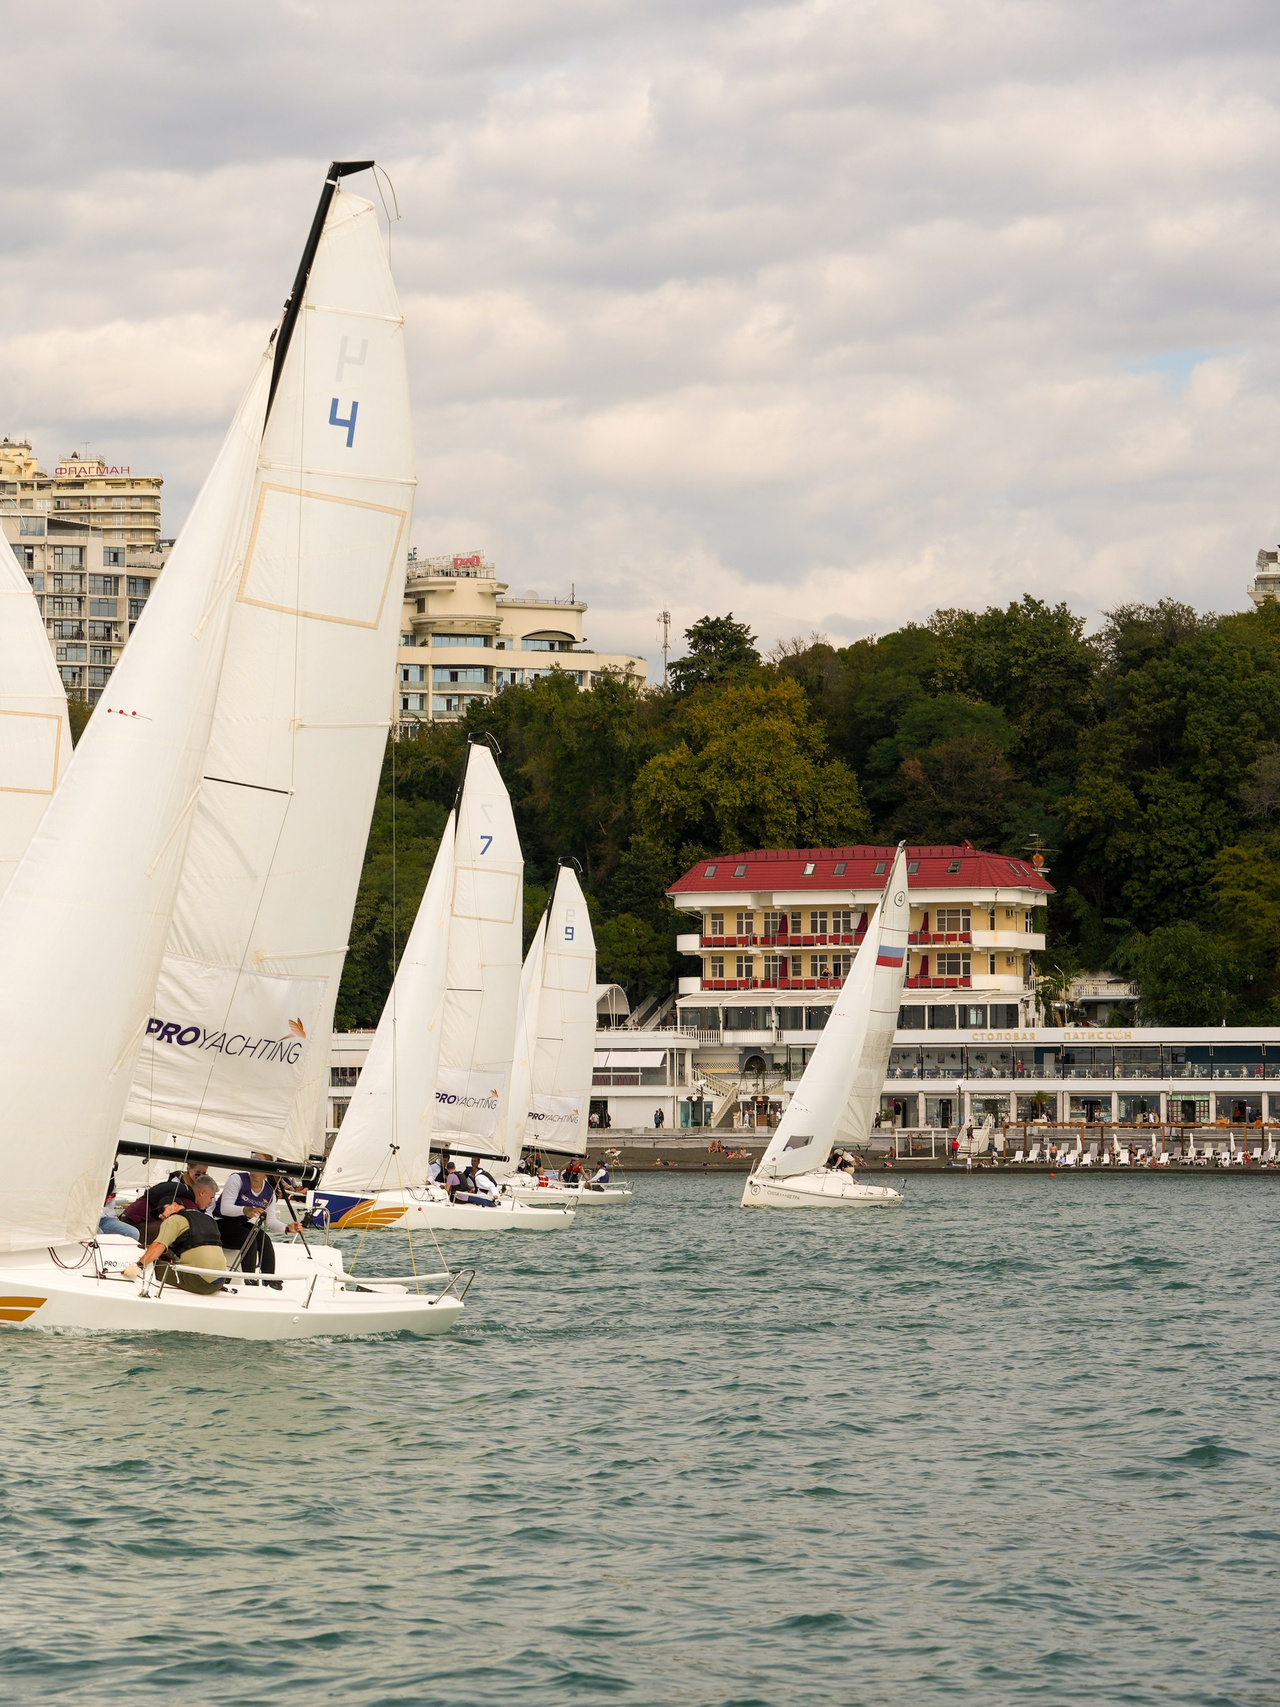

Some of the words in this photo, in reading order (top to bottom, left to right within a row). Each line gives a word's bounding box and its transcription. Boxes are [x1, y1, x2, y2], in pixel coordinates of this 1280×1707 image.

[328, 397, 359, 448] 4
[55, 466, 130, 475] ФЛАГМАН
[480, 835, 493, 855] 7
[565, 926, 575, 941] 9
[145, 1017, 302, 1065] PROYACHTING
[972, 1032, 1036, 1041] СТОЛОВАЯ
[313, 1198, 329, 1217] 7
